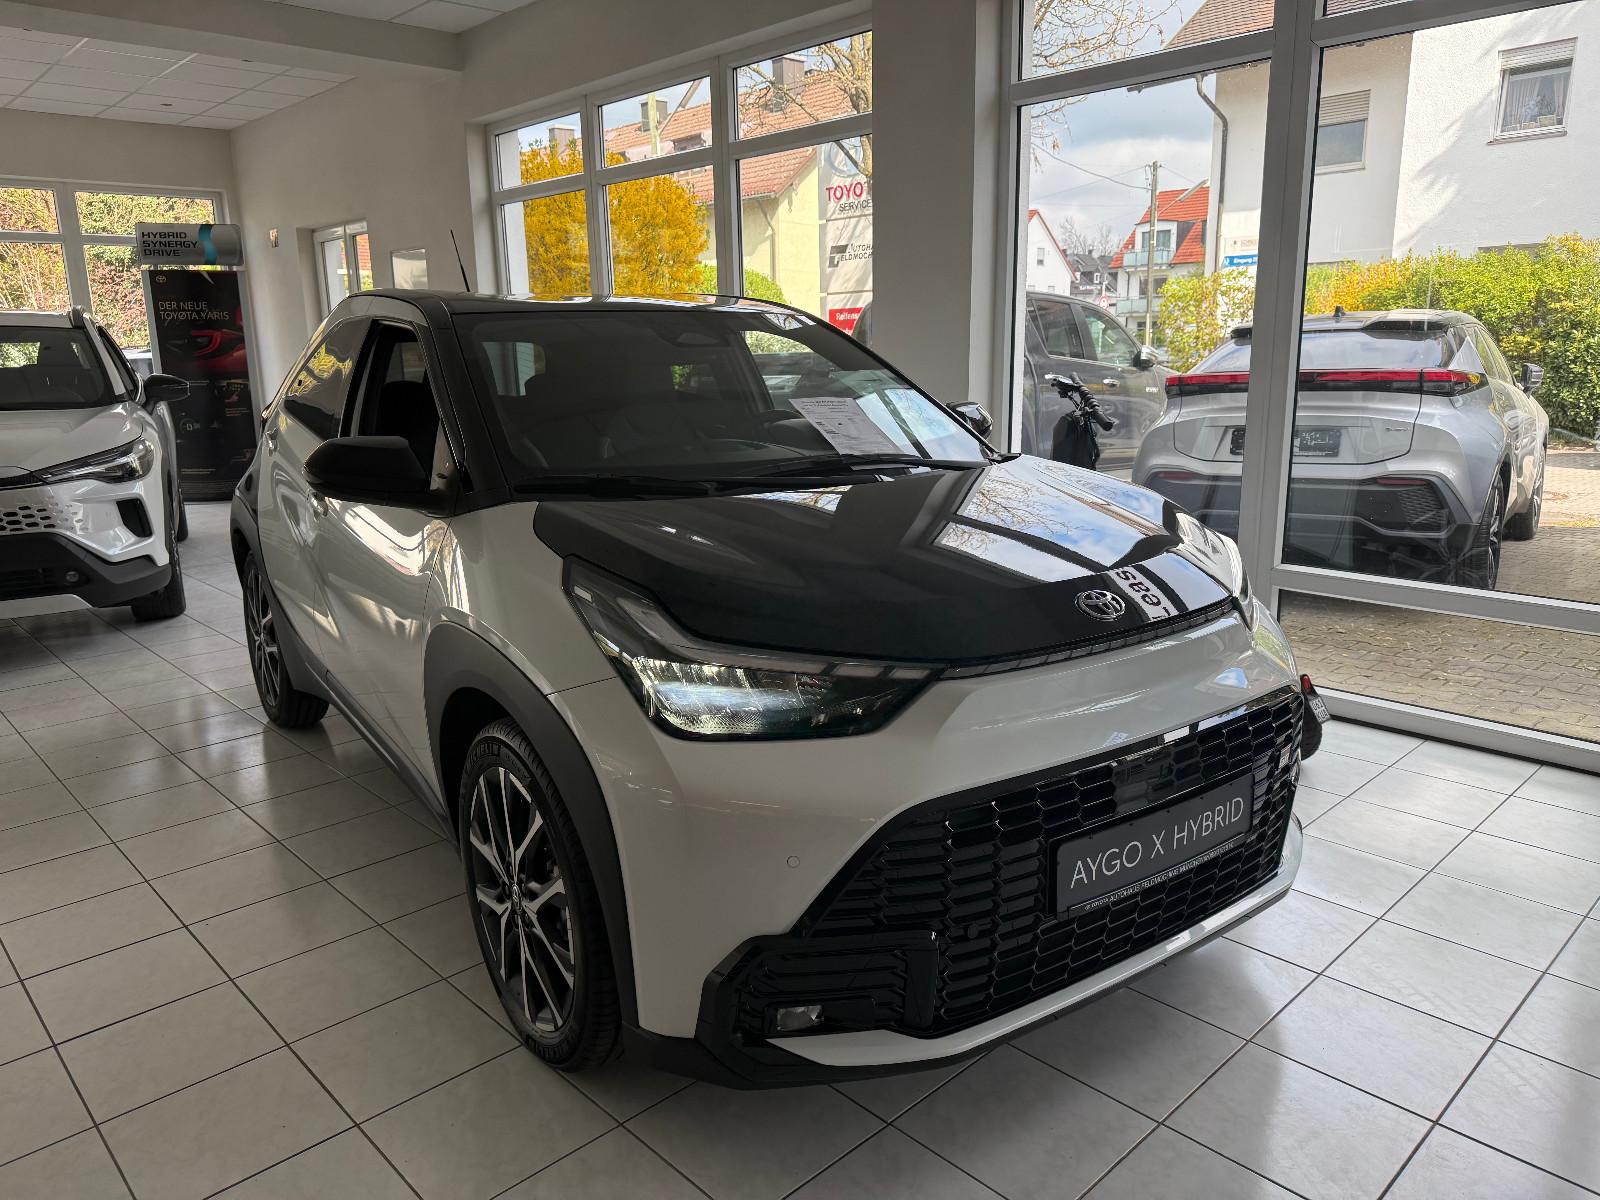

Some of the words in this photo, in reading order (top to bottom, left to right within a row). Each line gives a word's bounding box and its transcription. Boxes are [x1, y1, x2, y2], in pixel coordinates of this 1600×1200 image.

[826, 182, 866, 201] TOYO
[839, 199, 872, 211] SERVICE
[141, 231, 187, 239] HYBRID
[143, 240, 198, 249] SYNERGY
[849, 244, 872, 254] AUTOH
[143, 249, 181, 257] DRIVE
[159, 301, 178, 310] DER
[180, 301, 208, 310] NEUE
[200, 311, 230, 320] YARIS
[1070, 841, 1142, 889] AYGO
[1150, 829, 1165, 859] X
[1173, 797, 1244, 850] HYBRID
